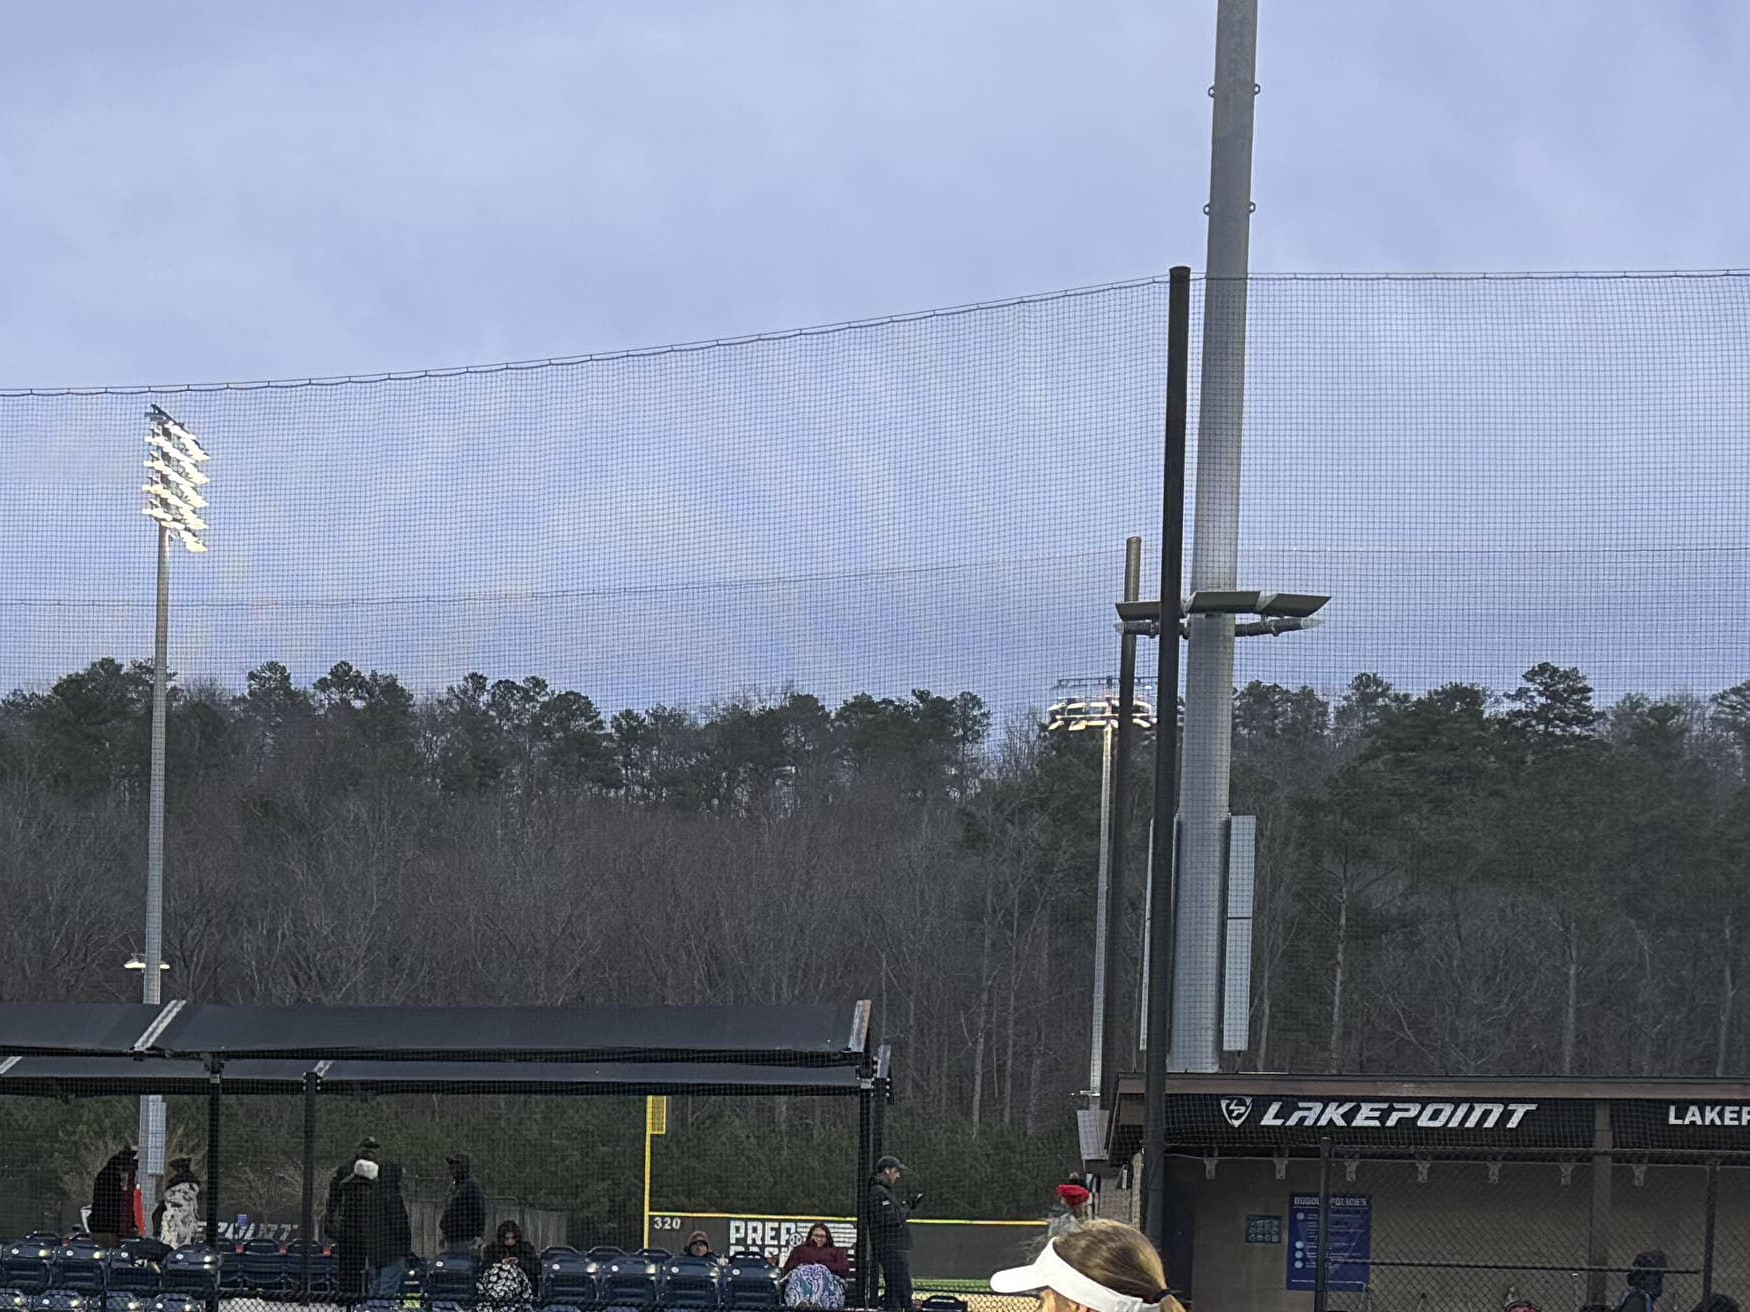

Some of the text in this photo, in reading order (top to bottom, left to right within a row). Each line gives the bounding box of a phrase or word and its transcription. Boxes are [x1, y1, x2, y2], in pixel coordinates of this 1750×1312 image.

[1259, 1101, 1539, 1129] LAKEPOINT
[653, 1217, 681, 1230] 320
[729, 1220, 796, 1246] PREP
